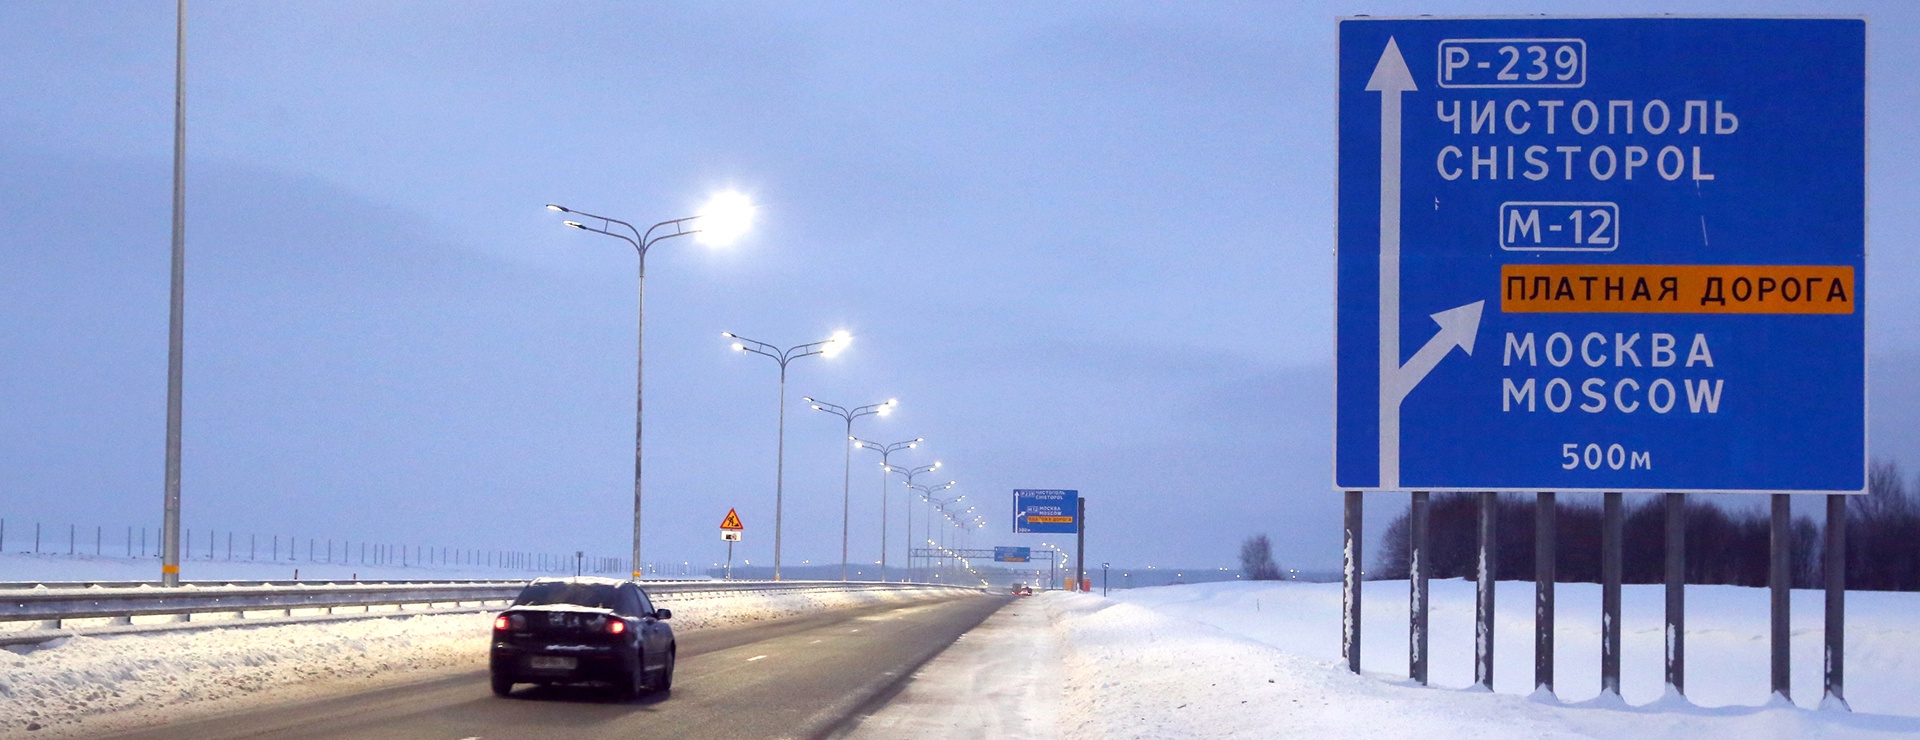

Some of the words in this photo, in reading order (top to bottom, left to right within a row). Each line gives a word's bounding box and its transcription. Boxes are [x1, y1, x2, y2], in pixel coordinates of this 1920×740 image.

[1446, 46, 1578, 81] Р-239
[1437, 100, 1739, 135] ЧИСТОПОЛЬ
[1436, 146, 1715, 180] CHISTOPOL
[1507, 210, 1611, 244] М-12
[1507, 276, 1679, 302] ПЛАТНАЯ
[1701, 277, 1848, 306] ДОРОГА
[1503, 332, 1714, 368] МОСКВА
[1502, 378, 1724, 414] MOSCOW
